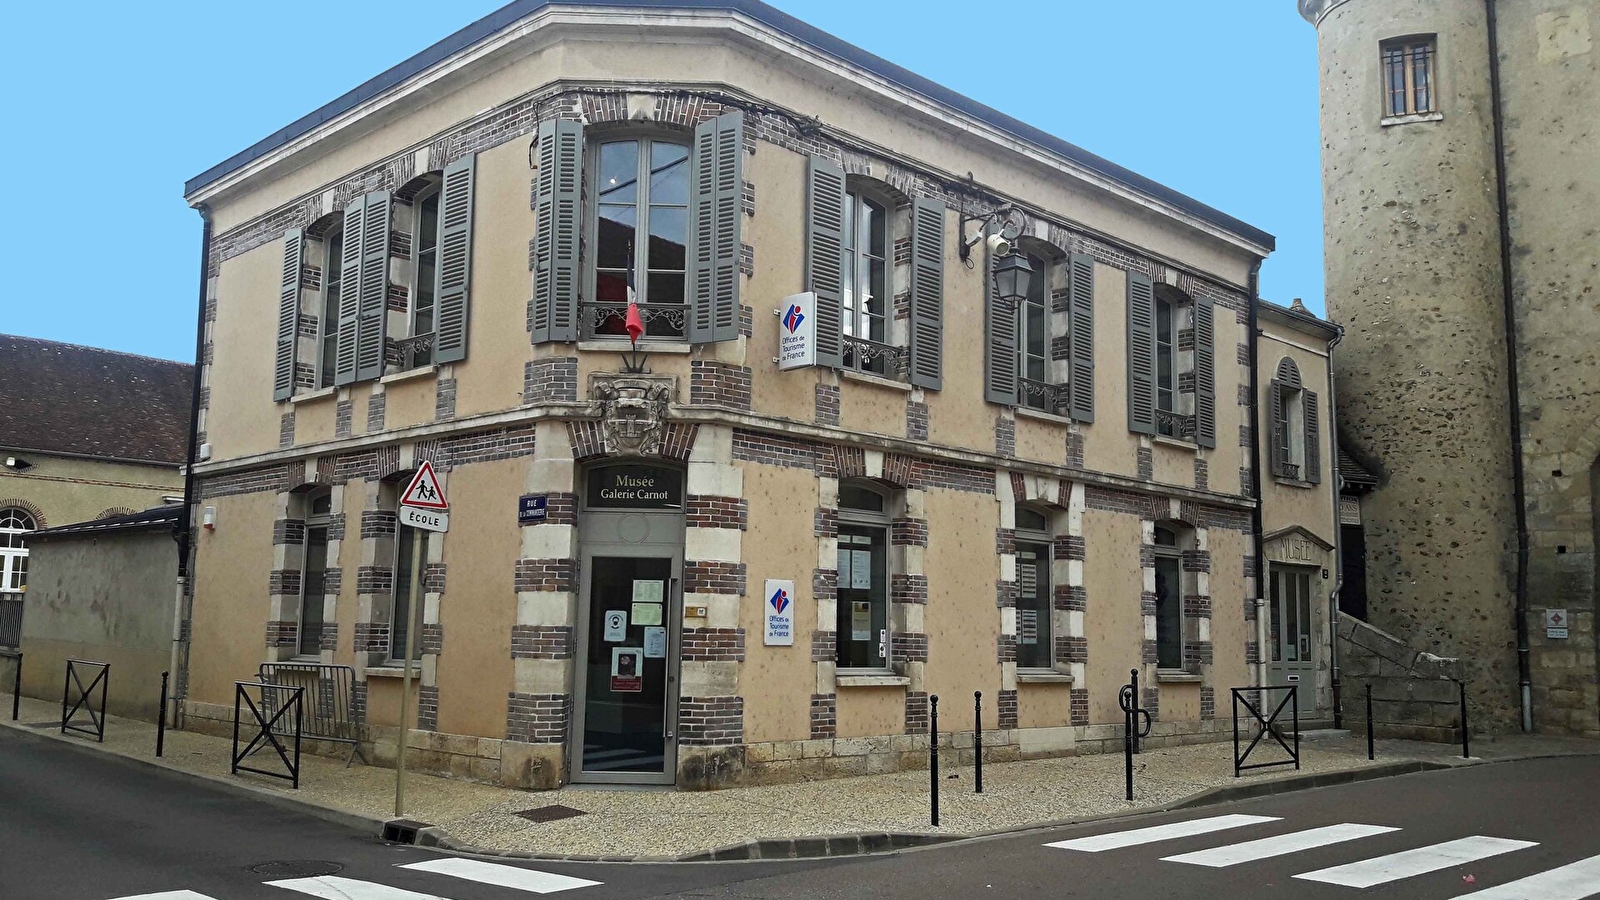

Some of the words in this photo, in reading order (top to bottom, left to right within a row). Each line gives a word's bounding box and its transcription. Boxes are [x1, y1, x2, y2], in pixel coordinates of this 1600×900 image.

[782, 336, 798, 344] Offices
[782, 342, 805, 353] Tourisme
[787, 351, 805, 360] France
[616, 475, 654, 487] Musée
[600, 488, 635, 499] Galerie
[637, 489, 669, 500] Carnot
[410, 511, 439, 526] ÉCOLE
[770, 622, 789, 630] Tourisme
